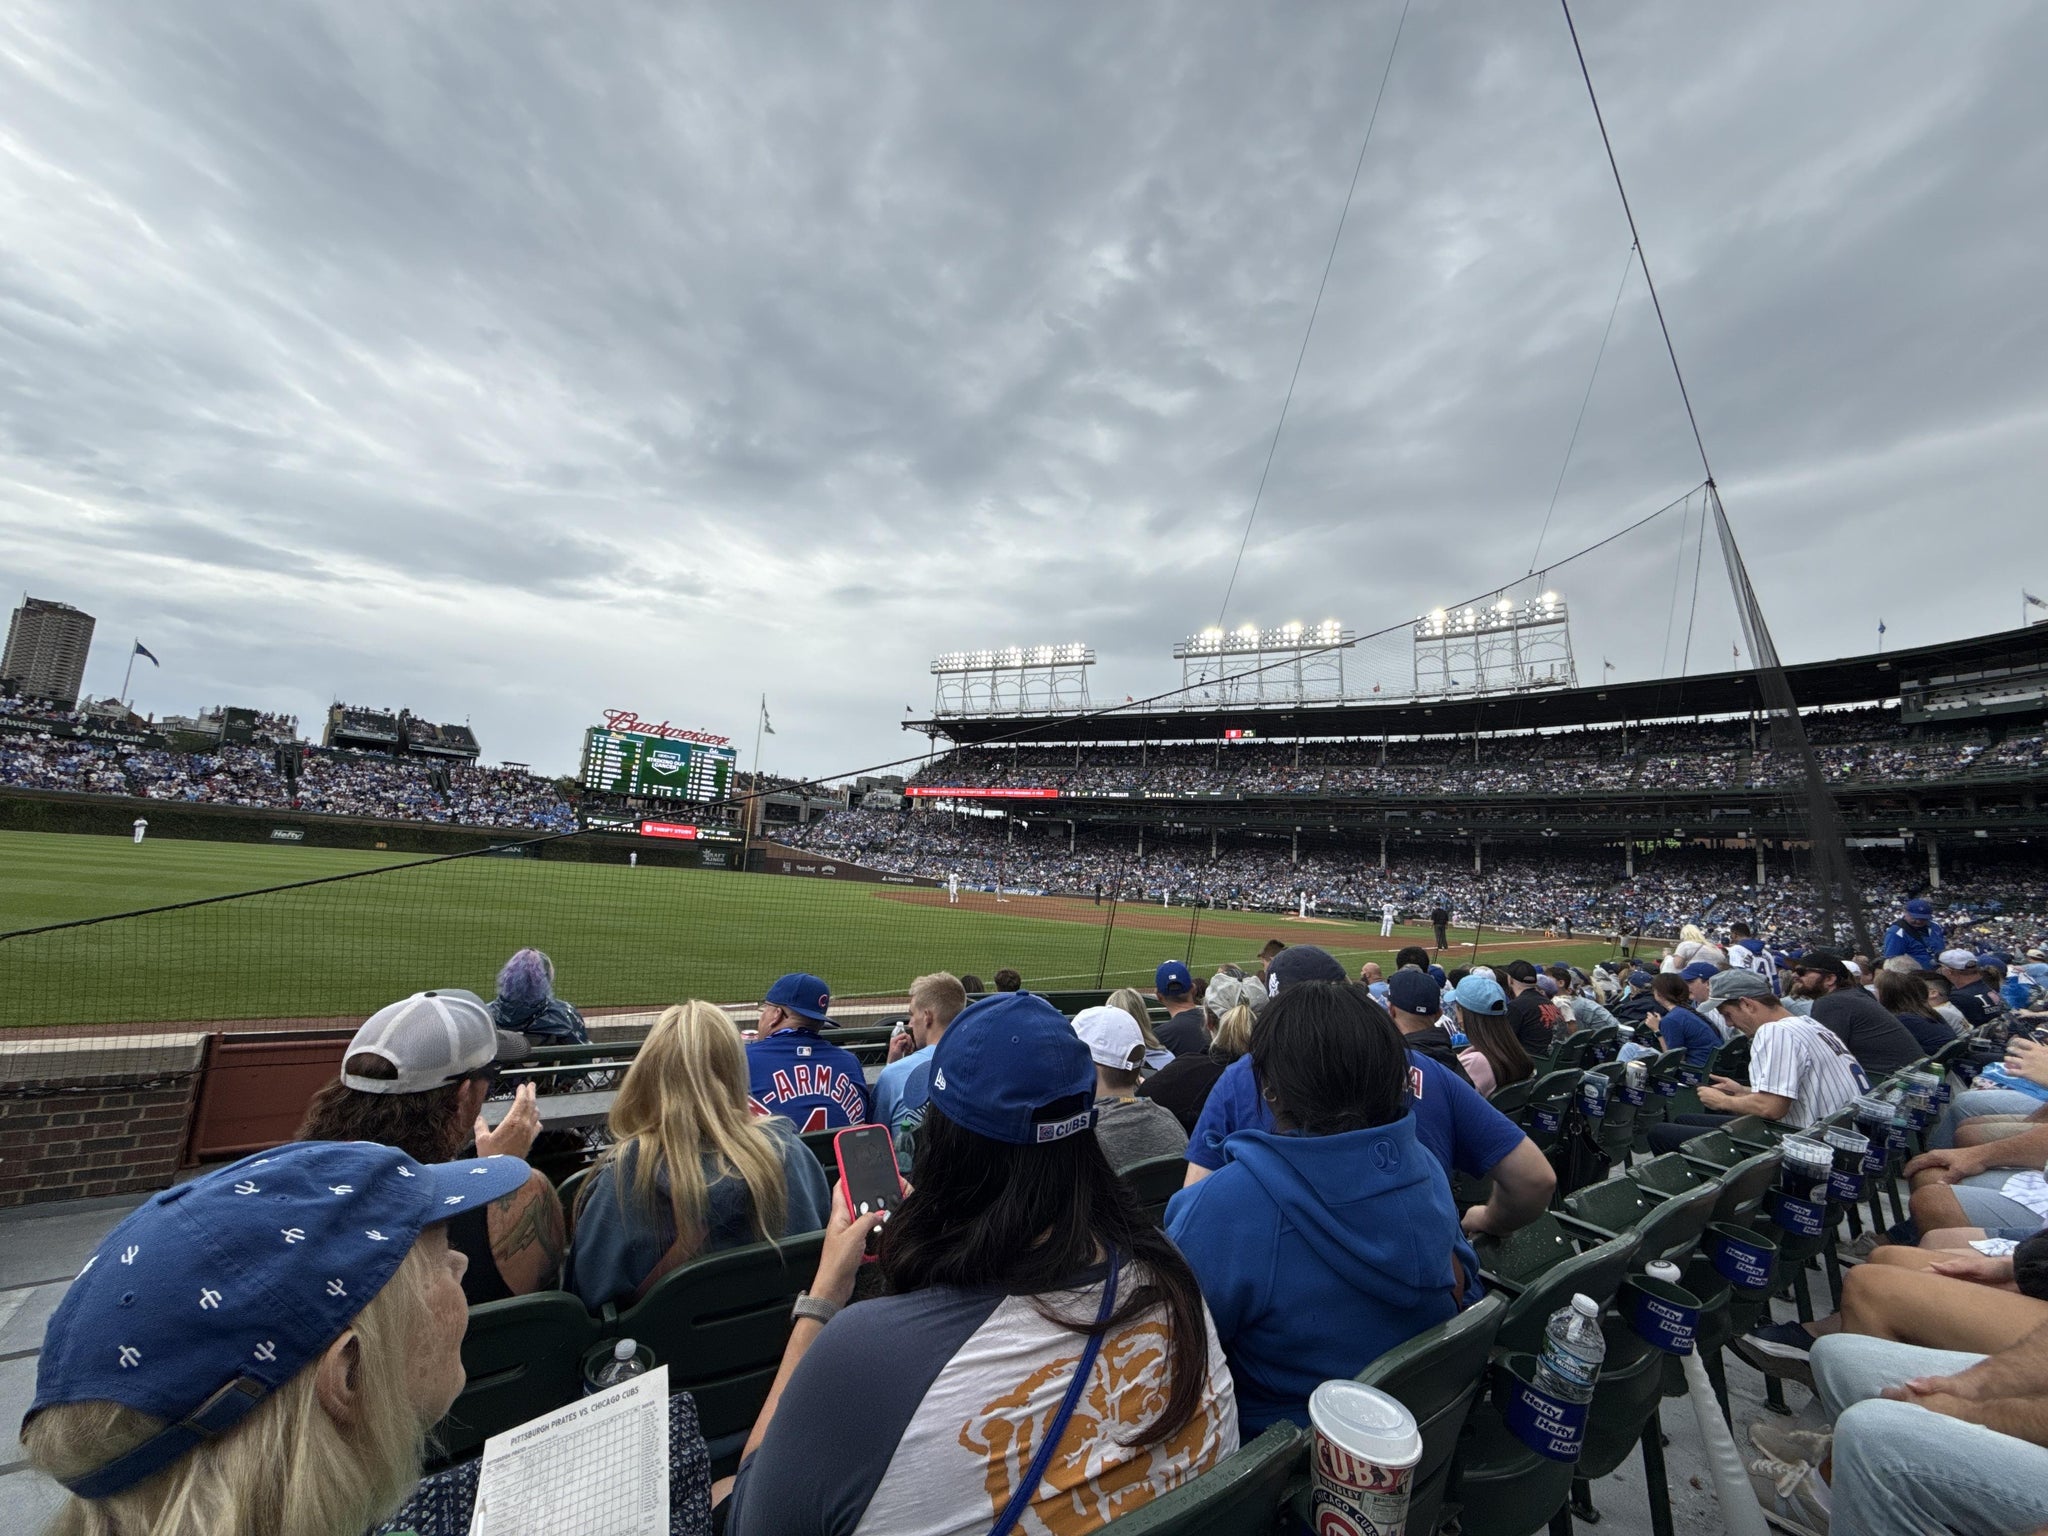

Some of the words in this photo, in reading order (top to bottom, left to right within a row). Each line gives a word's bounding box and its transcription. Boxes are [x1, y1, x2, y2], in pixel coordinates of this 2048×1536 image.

[89, 729, 146, 743] Advocate
[603, 709, 730, 745] Budweiser
[273, 831, 301, 840] Hefty
[748, 1064, 866, 1126] -ARMSTR
[1056, 1116, 1087, 1137] CUBS
[1727, 1248, 1755, 1264] Hefty
[1738, 1264, 1763, 1276] Hefty
[1649, 1302, 1681, 1321] Hefty
[1661, 1321, 1691, 1336] Hefty
[1556, 1358, 1589, 1380] MOUNTAIN
[1523, 1392, 1561, 1418] Hefty
[510, 1423, 550, 1446] PITTSBURGH
[551, 1412, 577, 1429] PIRATES
[590, 1394, 620, 1413] CHICAGO
[621, 1385, 640, 1400] CUBS
[1536, 1419, 1574, 1439] Hefty
[1317, 1438, 1394, 1487] CUBS
[1314, 1492, 1350, 1512] CHICAGO
